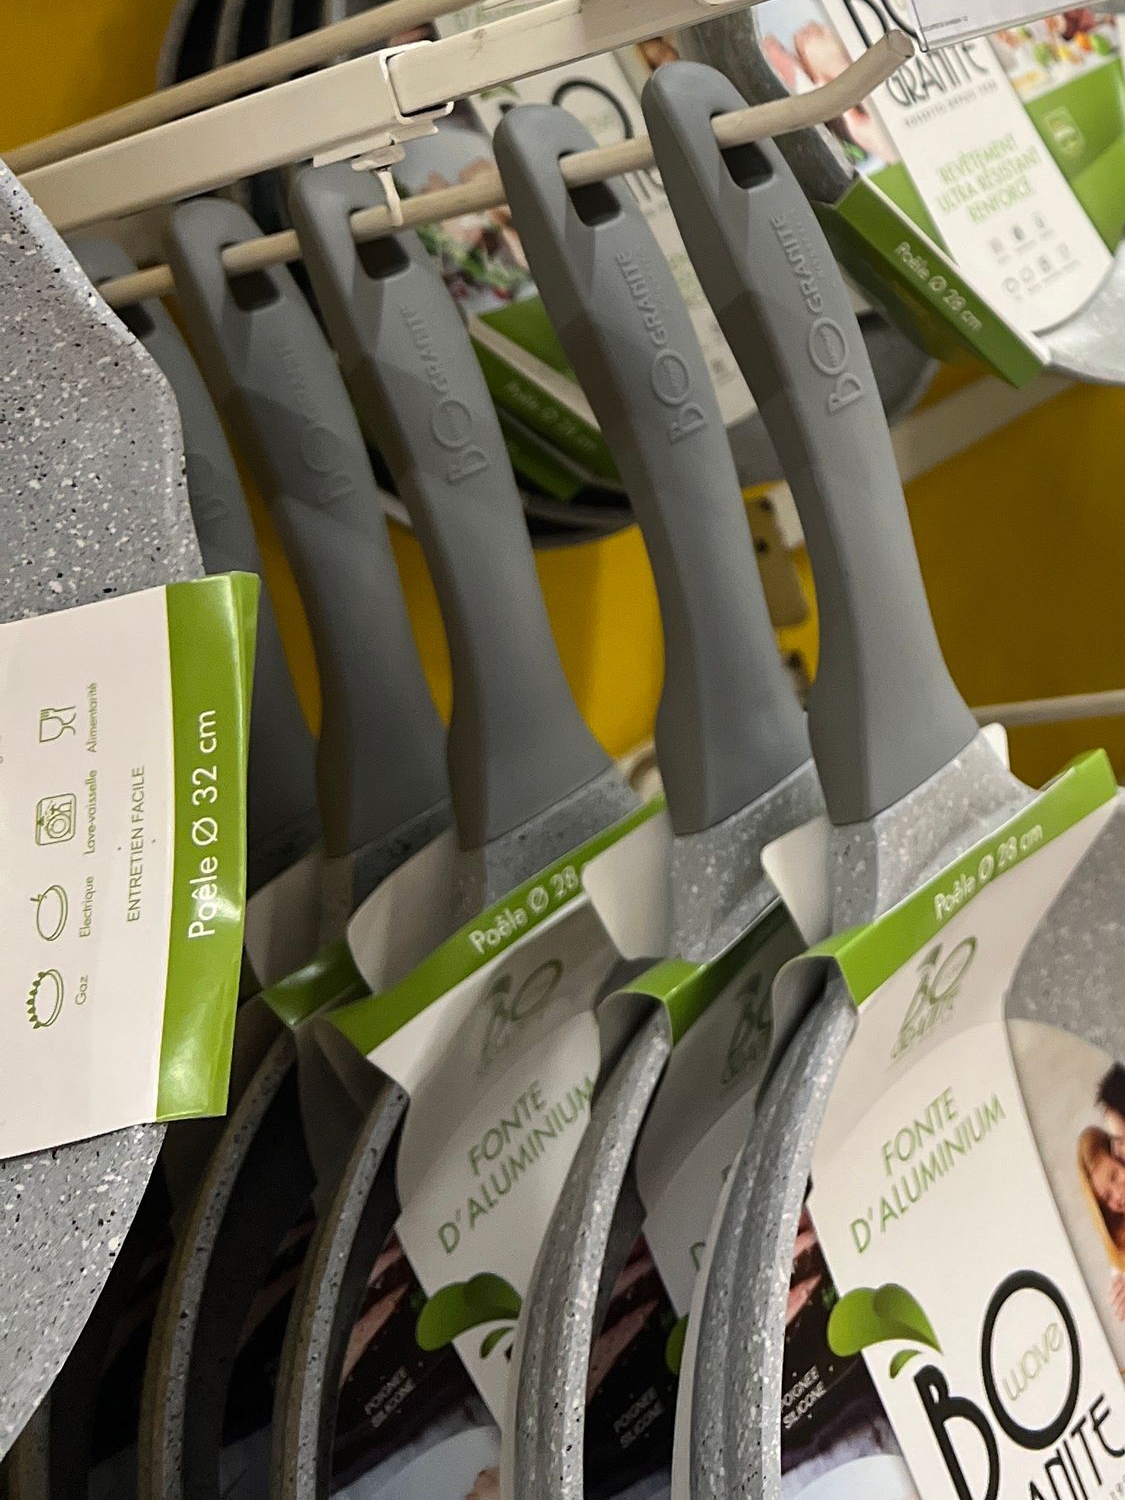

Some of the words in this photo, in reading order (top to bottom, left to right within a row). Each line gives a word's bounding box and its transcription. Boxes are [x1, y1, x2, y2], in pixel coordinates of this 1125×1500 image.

[199, 709, 217, 754] cm
[131, 766, 145, 823] FACILE
[192, 766, 217, 805] 32
[79, 875, 95, 938] Electrique
[127, 827, 144, 923] ENTRETIEN
[188, 856, 218, 939] Poêle
[468, 908, 528, 955] Poêle
[551, 865, 579, 898] 28
[934, 873, 976, 920] Poêle
[997, 836, 1018, 867] 28
[1020, 825, 1042, 851] cm
[75, 975, 88, 1006] Gaz
[467, 1080, 546, 1176] FONTE
[880, 1086, 958, 1177] FONTE
[850, 1093, 1006, 1254] D'ALUMINIUM
